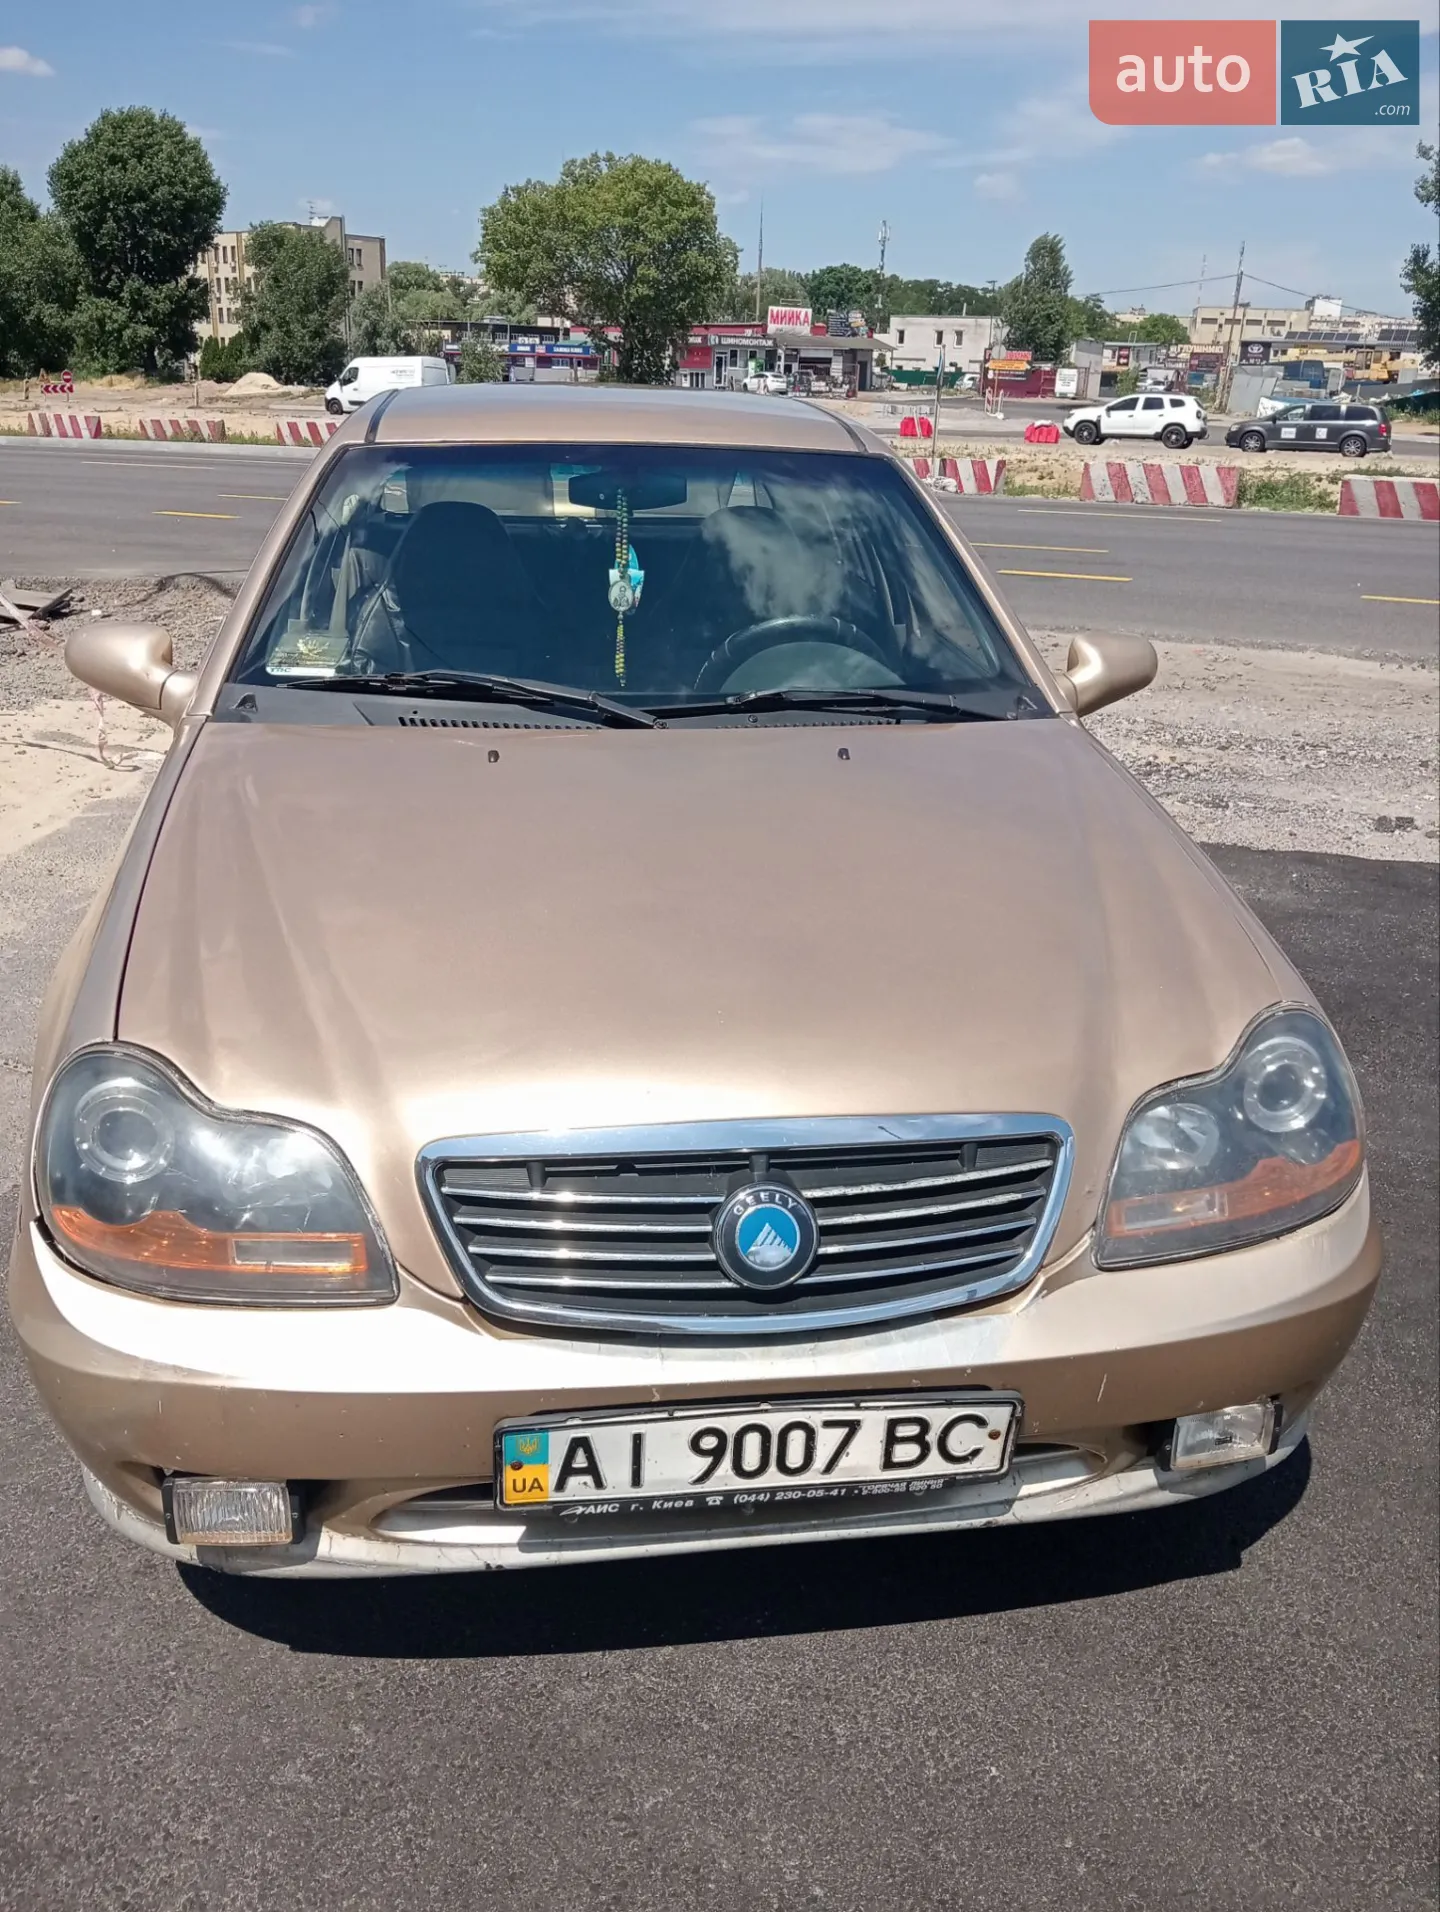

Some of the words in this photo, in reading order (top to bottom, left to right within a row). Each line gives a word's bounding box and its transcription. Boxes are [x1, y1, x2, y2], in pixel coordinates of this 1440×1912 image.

[720, 336, 774, 347] ШИНОМОНТАЖ
[733, 1191, 798, 1216] GEELY
[688, 1417, 862, 1486] 9007
[881, 1412, 989, 1472] BC
[512, 1477, 545, 1494] UA
[651, 1498, 694, 1510] Киев
[733, 1491, 771, 1505] (044)
[774, 1487, 847, 1501] 230-05-41
